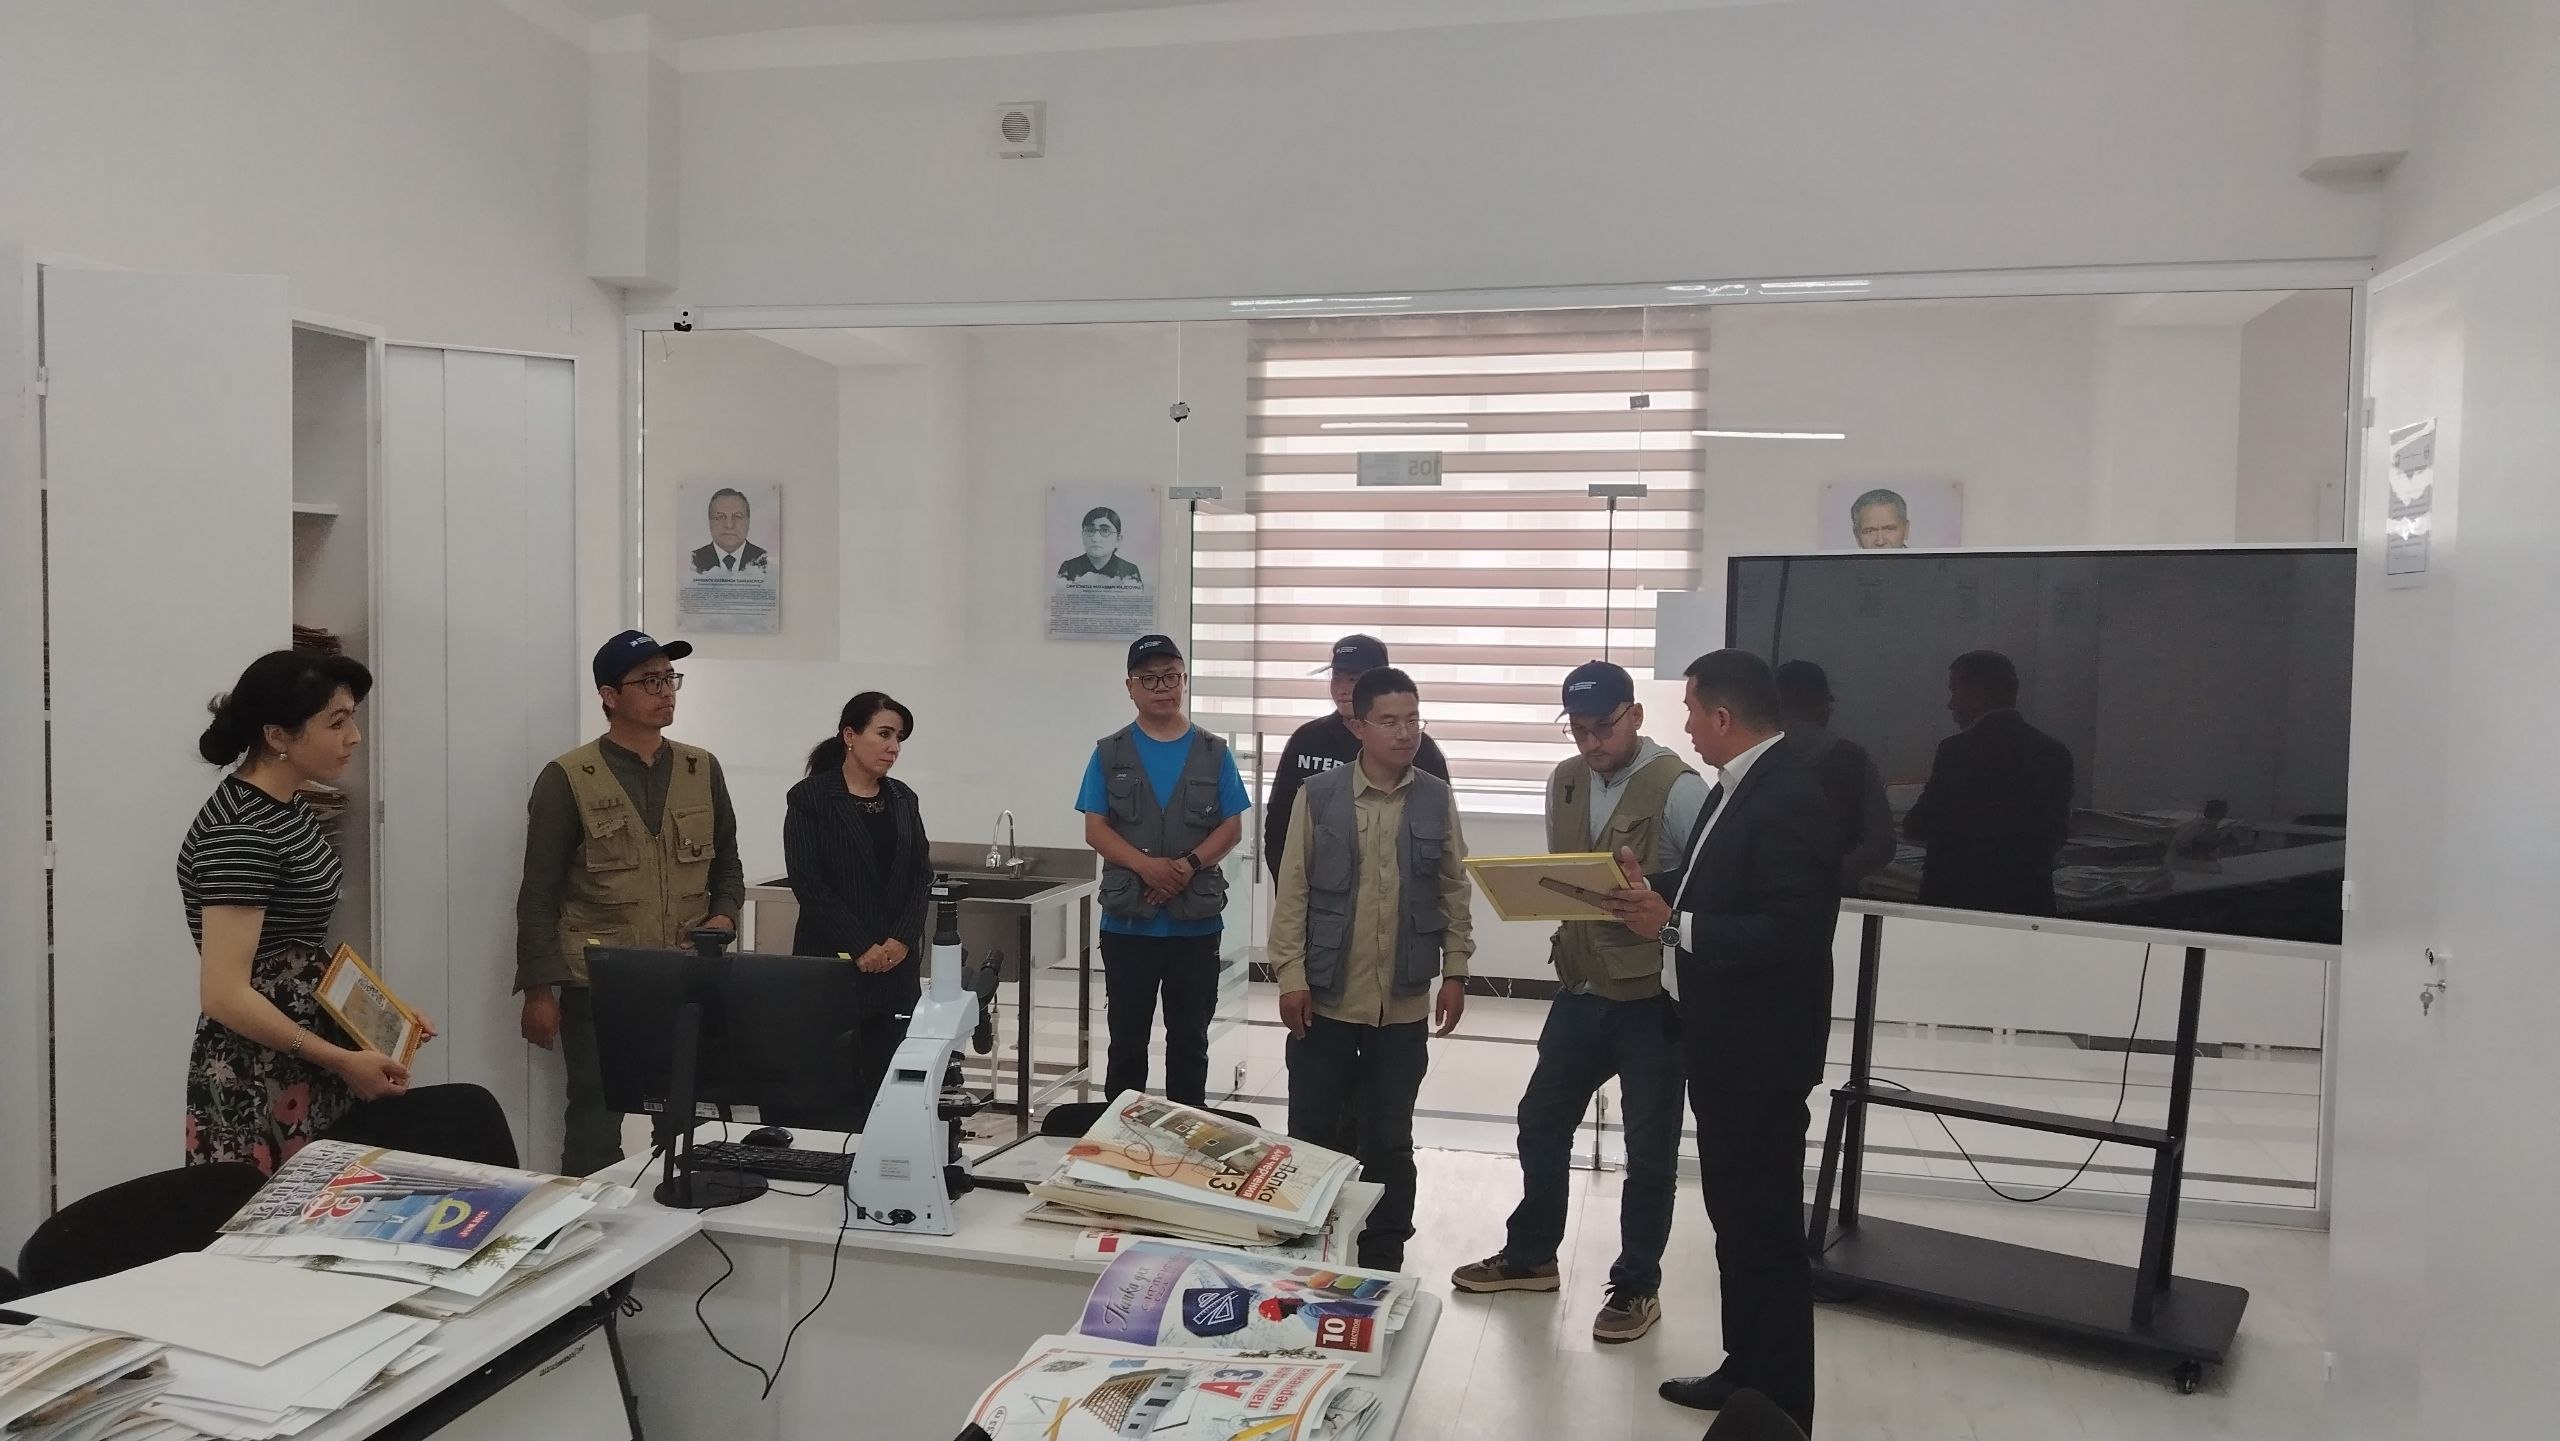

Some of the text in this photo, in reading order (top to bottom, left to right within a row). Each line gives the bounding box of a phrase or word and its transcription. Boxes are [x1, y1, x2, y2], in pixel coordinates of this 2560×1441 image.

[1242, 1160, 1275, 1198] черчения
[1257, 1163, 1298, 1203] Папка
[1322, 1318, 1347, 1345] 10
[1247, 1377, 1278, 1409] папка
